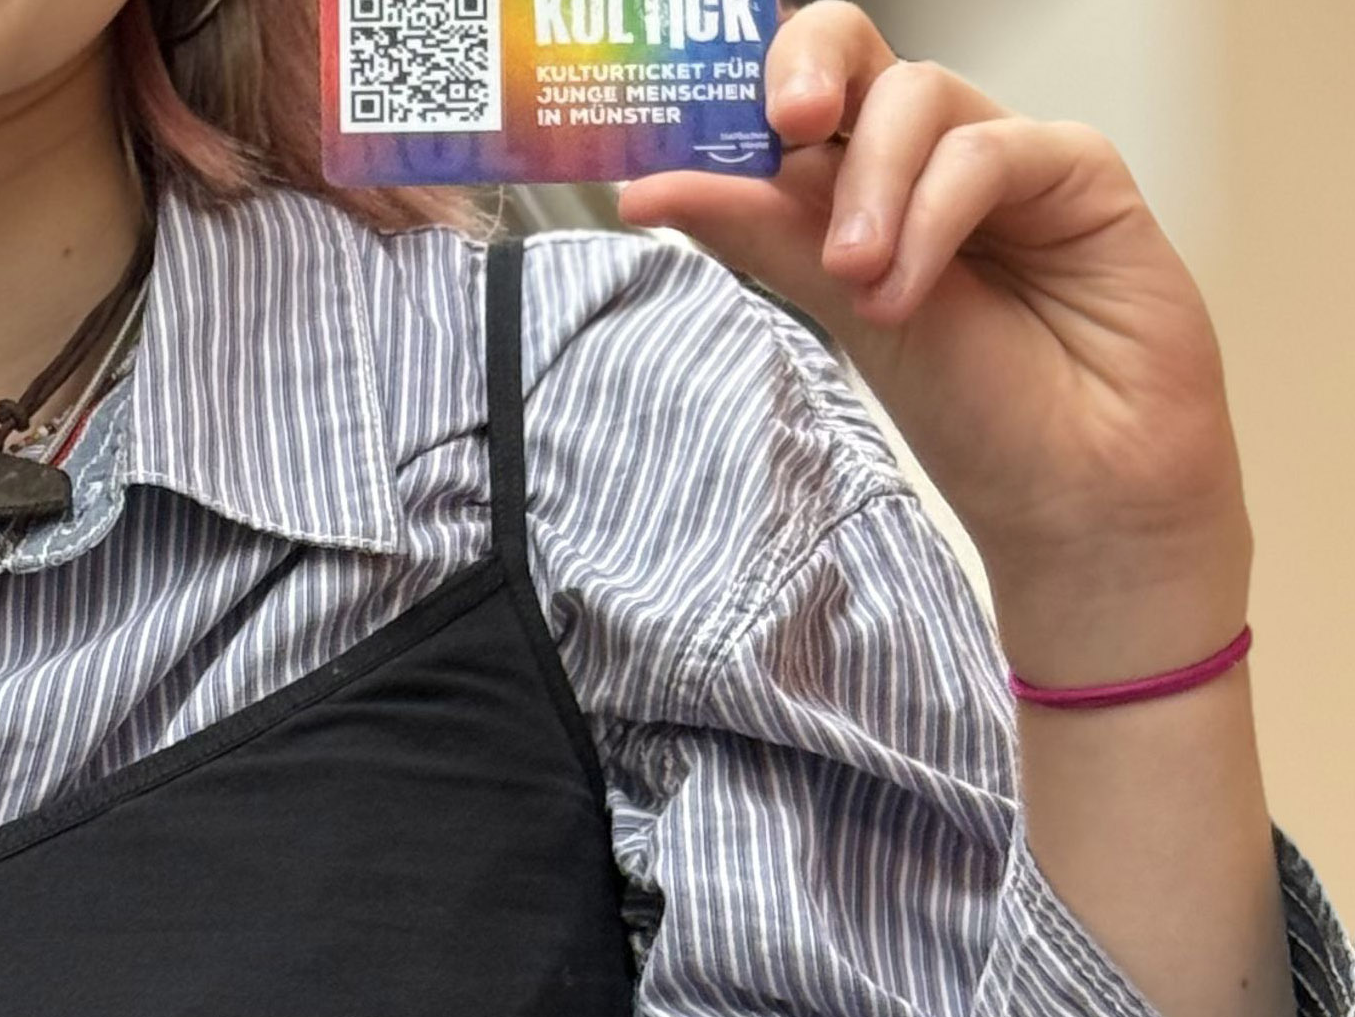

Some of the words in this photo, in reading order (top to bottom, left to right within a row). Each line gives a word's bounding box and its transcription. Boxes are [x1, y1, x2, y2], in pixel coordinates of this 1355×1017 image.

[537, 62, 706, 83] KULTURTICKET
[713, 56, 761, 80] FÜR
[536, 85, 618, 105] JUNGE
[626, 82, 757, 103] MENSCHEN
[536, 108, 562, 127] IN
[569, 104, 682, 126] MÜNSTER
